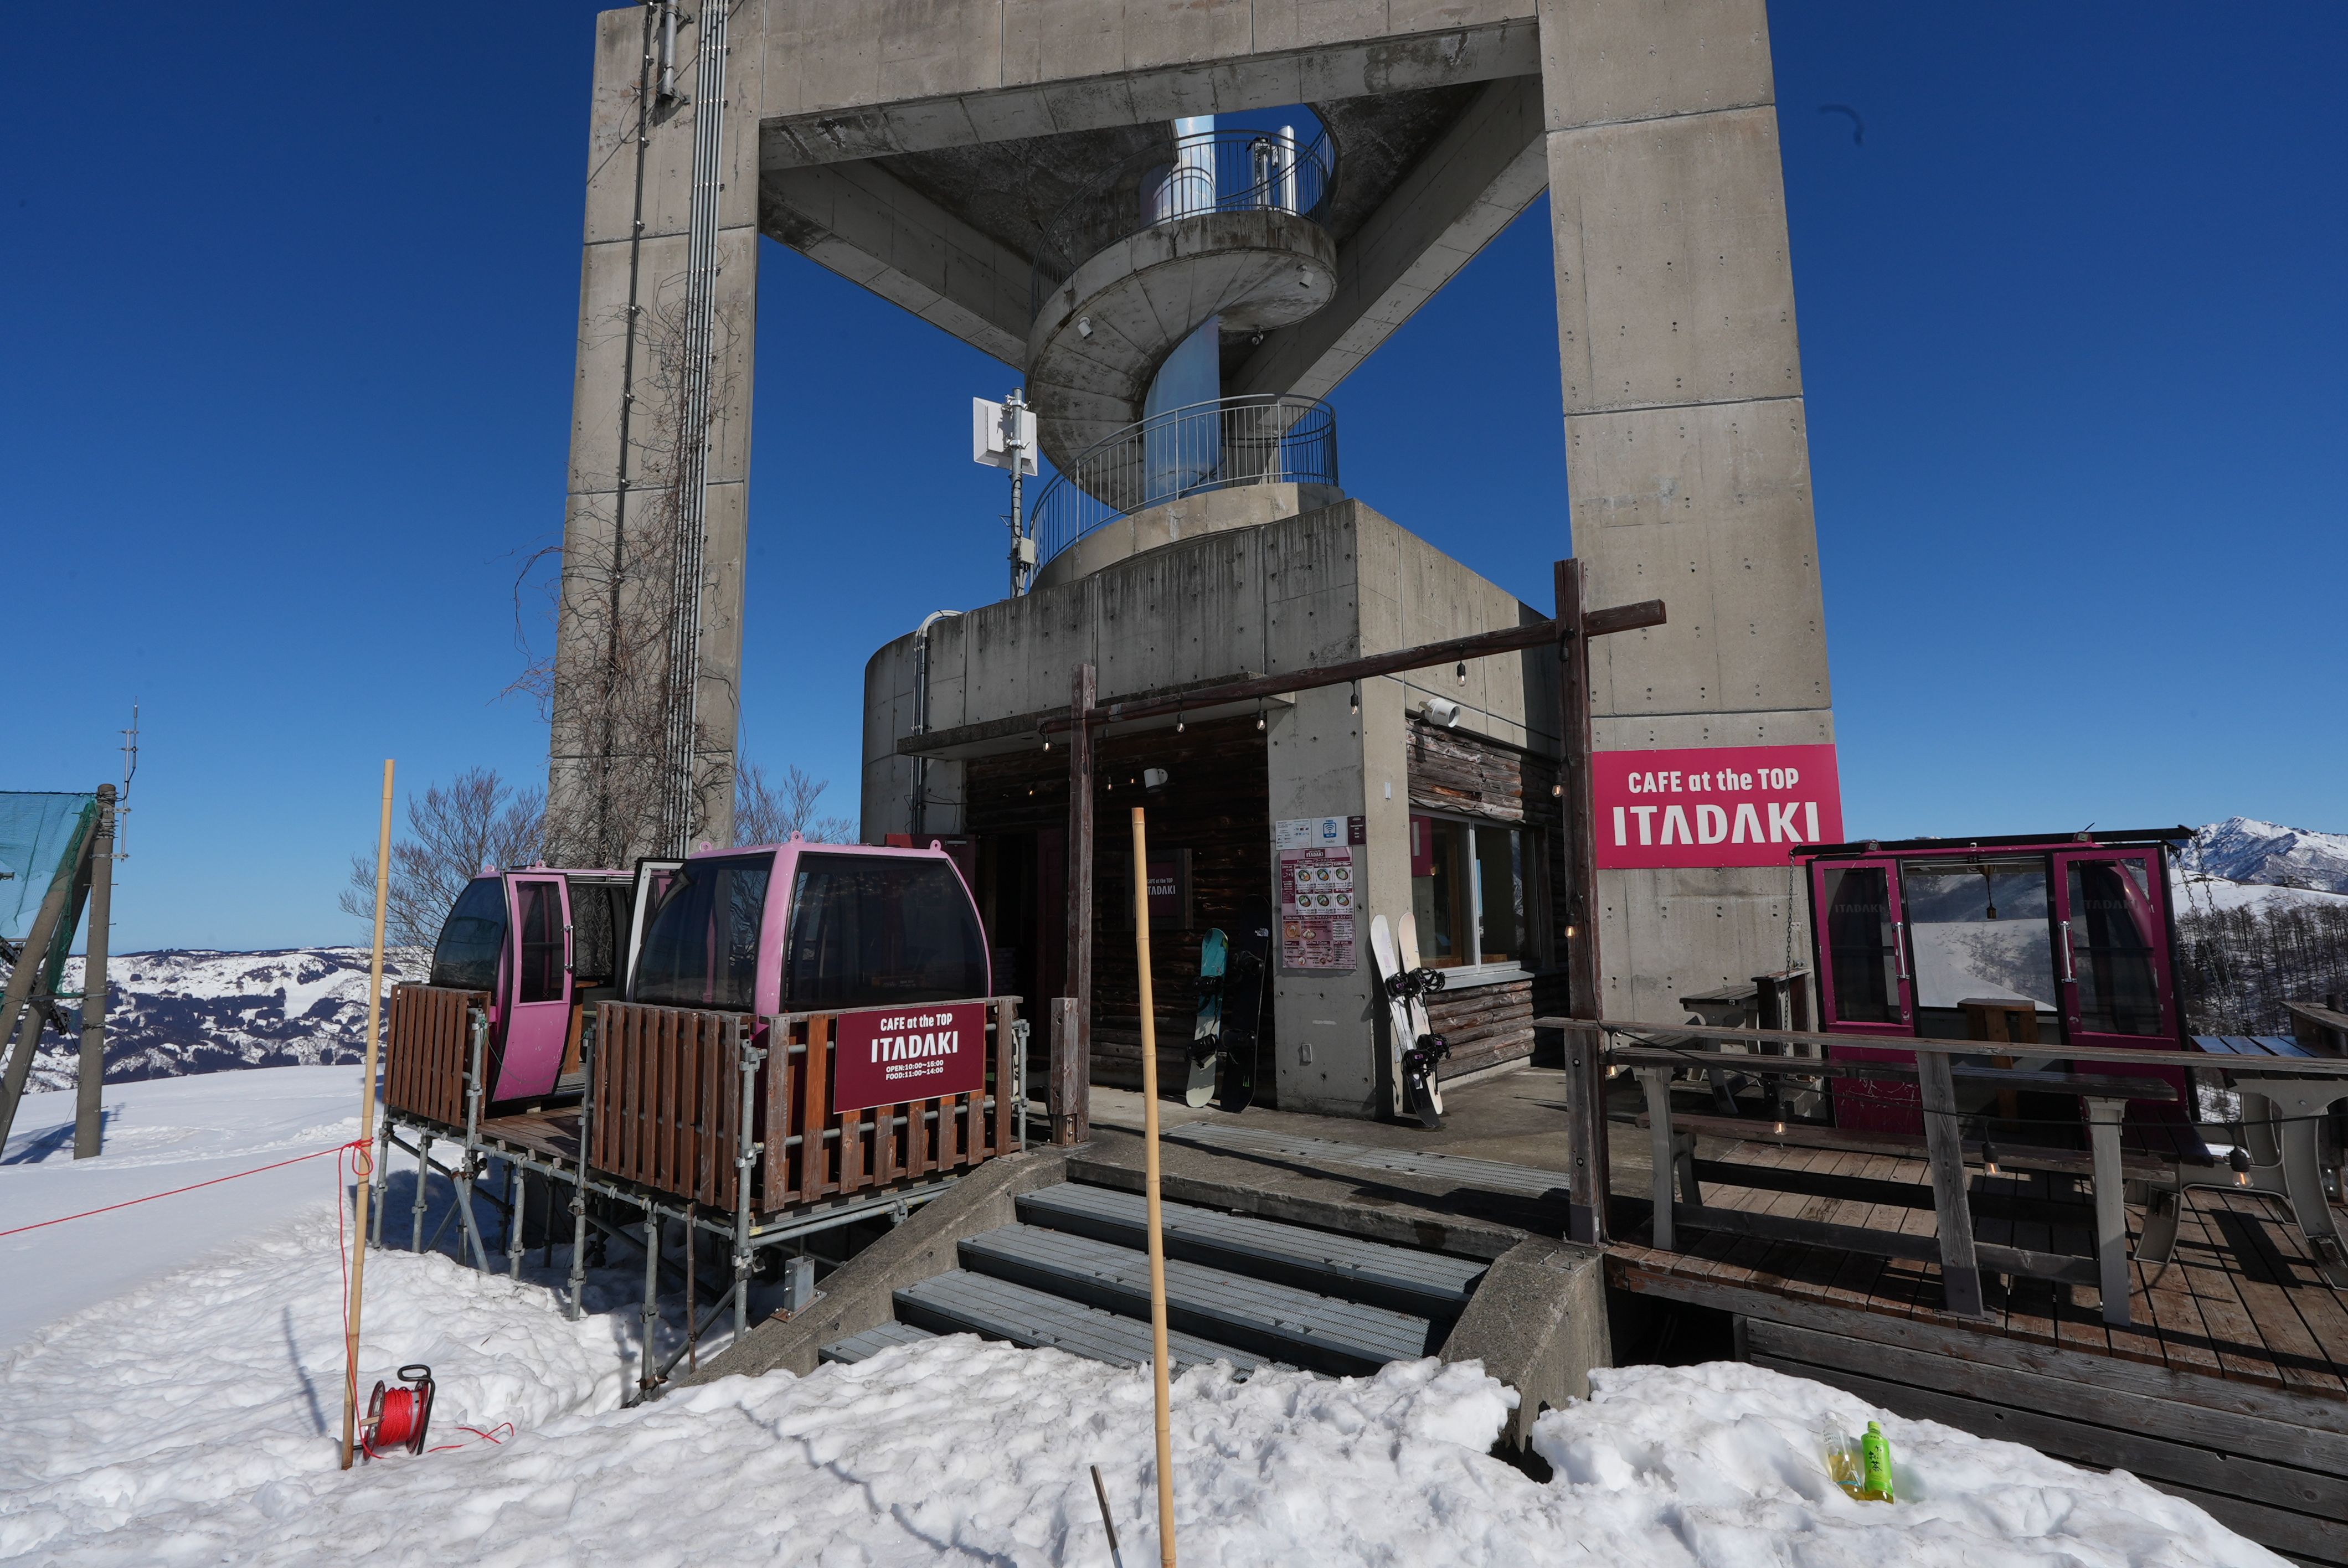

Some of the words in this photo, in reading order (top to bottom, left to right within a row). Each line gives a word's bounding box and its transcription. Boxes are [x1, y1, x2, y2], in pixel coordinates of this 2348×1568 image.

[1628, 771, 1682, 793] CAFE
[1688, 771, 1711, 792] at
[1716, 768, 1753, 791] the
[1758, 767, 1799, 790] TOP
[1613, 802, 1820, 846] ITADAKI
[1147, 885, 1176, 895] TADAKI
[881, 1017, 905, 1031] CAFE
[907, 1018, 917, 1029] at
[919, 1014, 934, 1028] the
[936, 1013, 952, 1027] TOP
[871, 1030, 959, 1063] ITADAKI
